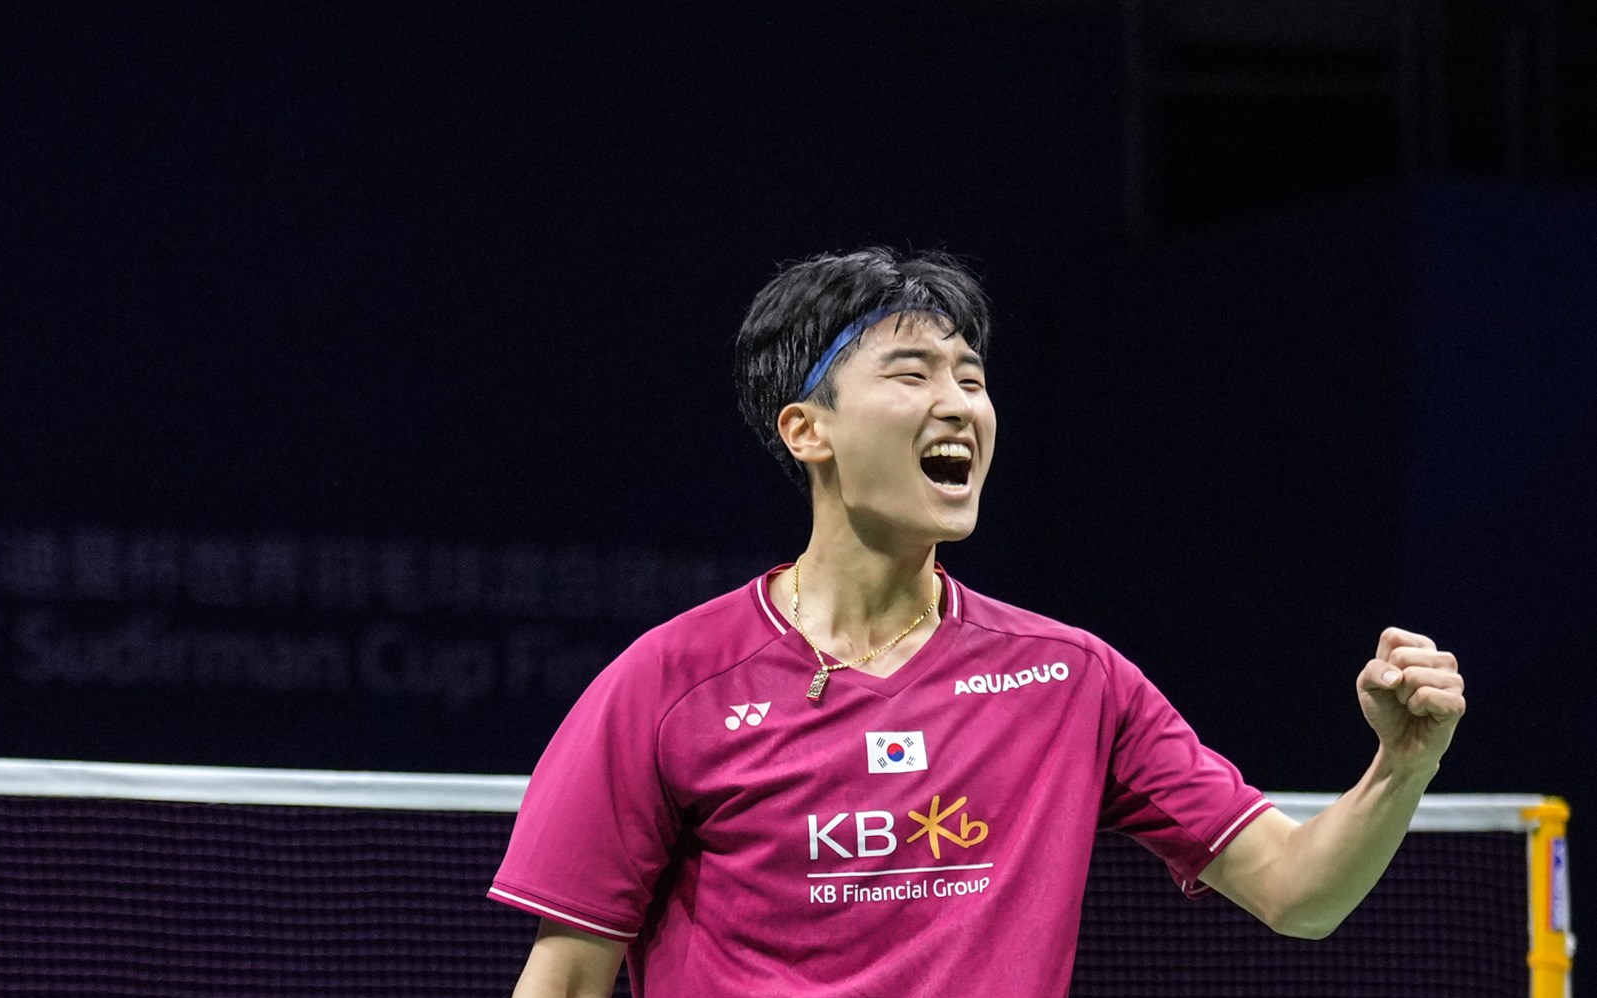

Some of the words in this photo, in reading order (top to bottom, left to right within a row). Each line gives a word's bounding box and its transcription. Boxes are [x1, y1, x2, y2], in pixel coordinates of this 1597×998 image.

[15, 607, 348, 690] Sudirman
[359, 621, 493, 709] Cup
[807, 810, 898, 860] KB
[809, 885, 837, 904] KB
[842, 880, 928, 903] Financial
[933, 877, 990, 899] Group
